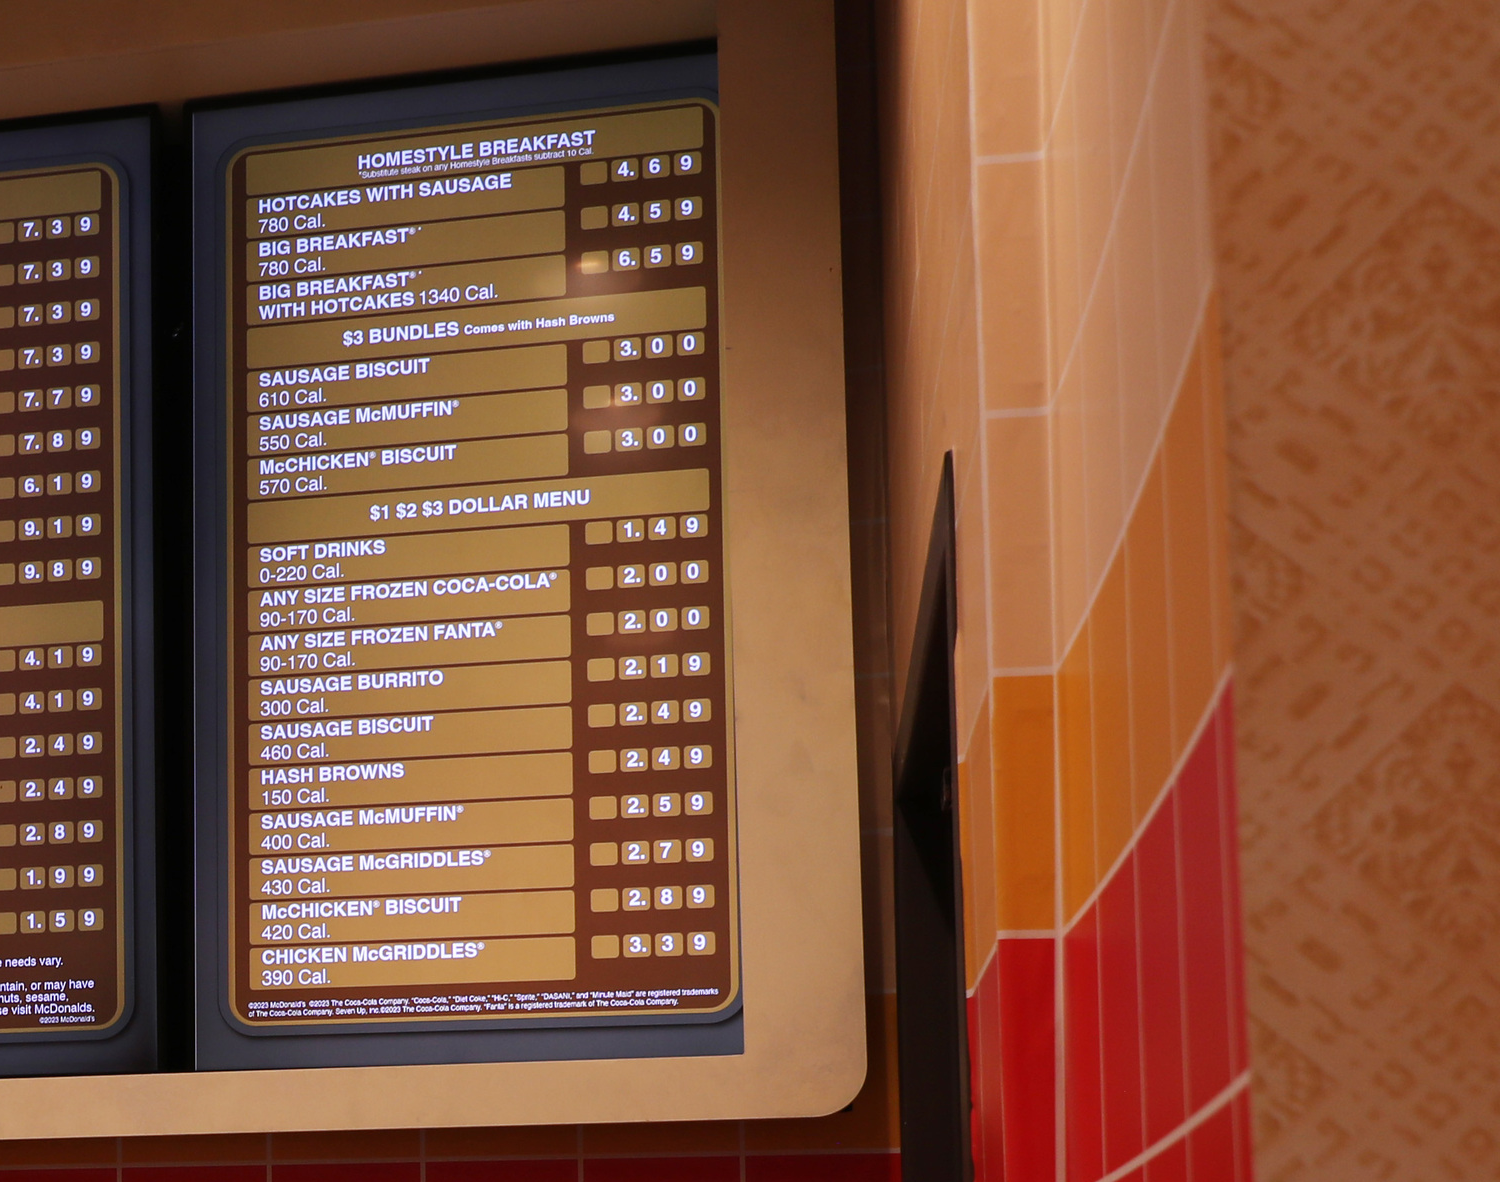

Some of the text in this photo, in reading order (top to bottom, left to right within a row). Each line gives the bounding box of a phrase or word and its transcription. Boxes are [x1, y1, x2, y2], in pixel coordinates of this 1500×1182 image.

[357, 129, 596, 170] HOMESTYLE BREAKFAST
[258, 172, 513, 214] HOTCAKES WITH SAUSAGE
[257, 212, 325, 234] 780 Cal.
[258, 283, 498, 320] WITH HOTCAKES 1340 Cal.
[342, 313, 615, 348] $3 BUNDLES Comes with Hash Browns
[258, 357, 431, 388] SAUSAGE BISCUIT
[380, 443, 458, 466] BISCUIT
[369, 488, 592, 522] $1 $2 $3 DOLLAR MENU
[259, 538, 387, 563] SOFT DRINKS
[259, 562, 344, 584] 0-220 Cal.
[259, 589, 299, 607] ANY
[303, 586, 346, 604] SIZE
[350, 580, 429, 601] FROZEN
[260, 762, 406, 785] HASH BROWNS
[261, 787, 329, 805] 150 Cal.
[4, 956, 37, 967] needs
[38, 956, 63, 967] vary.
[261, 946, 348, 965] CHICKEN
[261, 968, 331, 986] 390 Cal.
